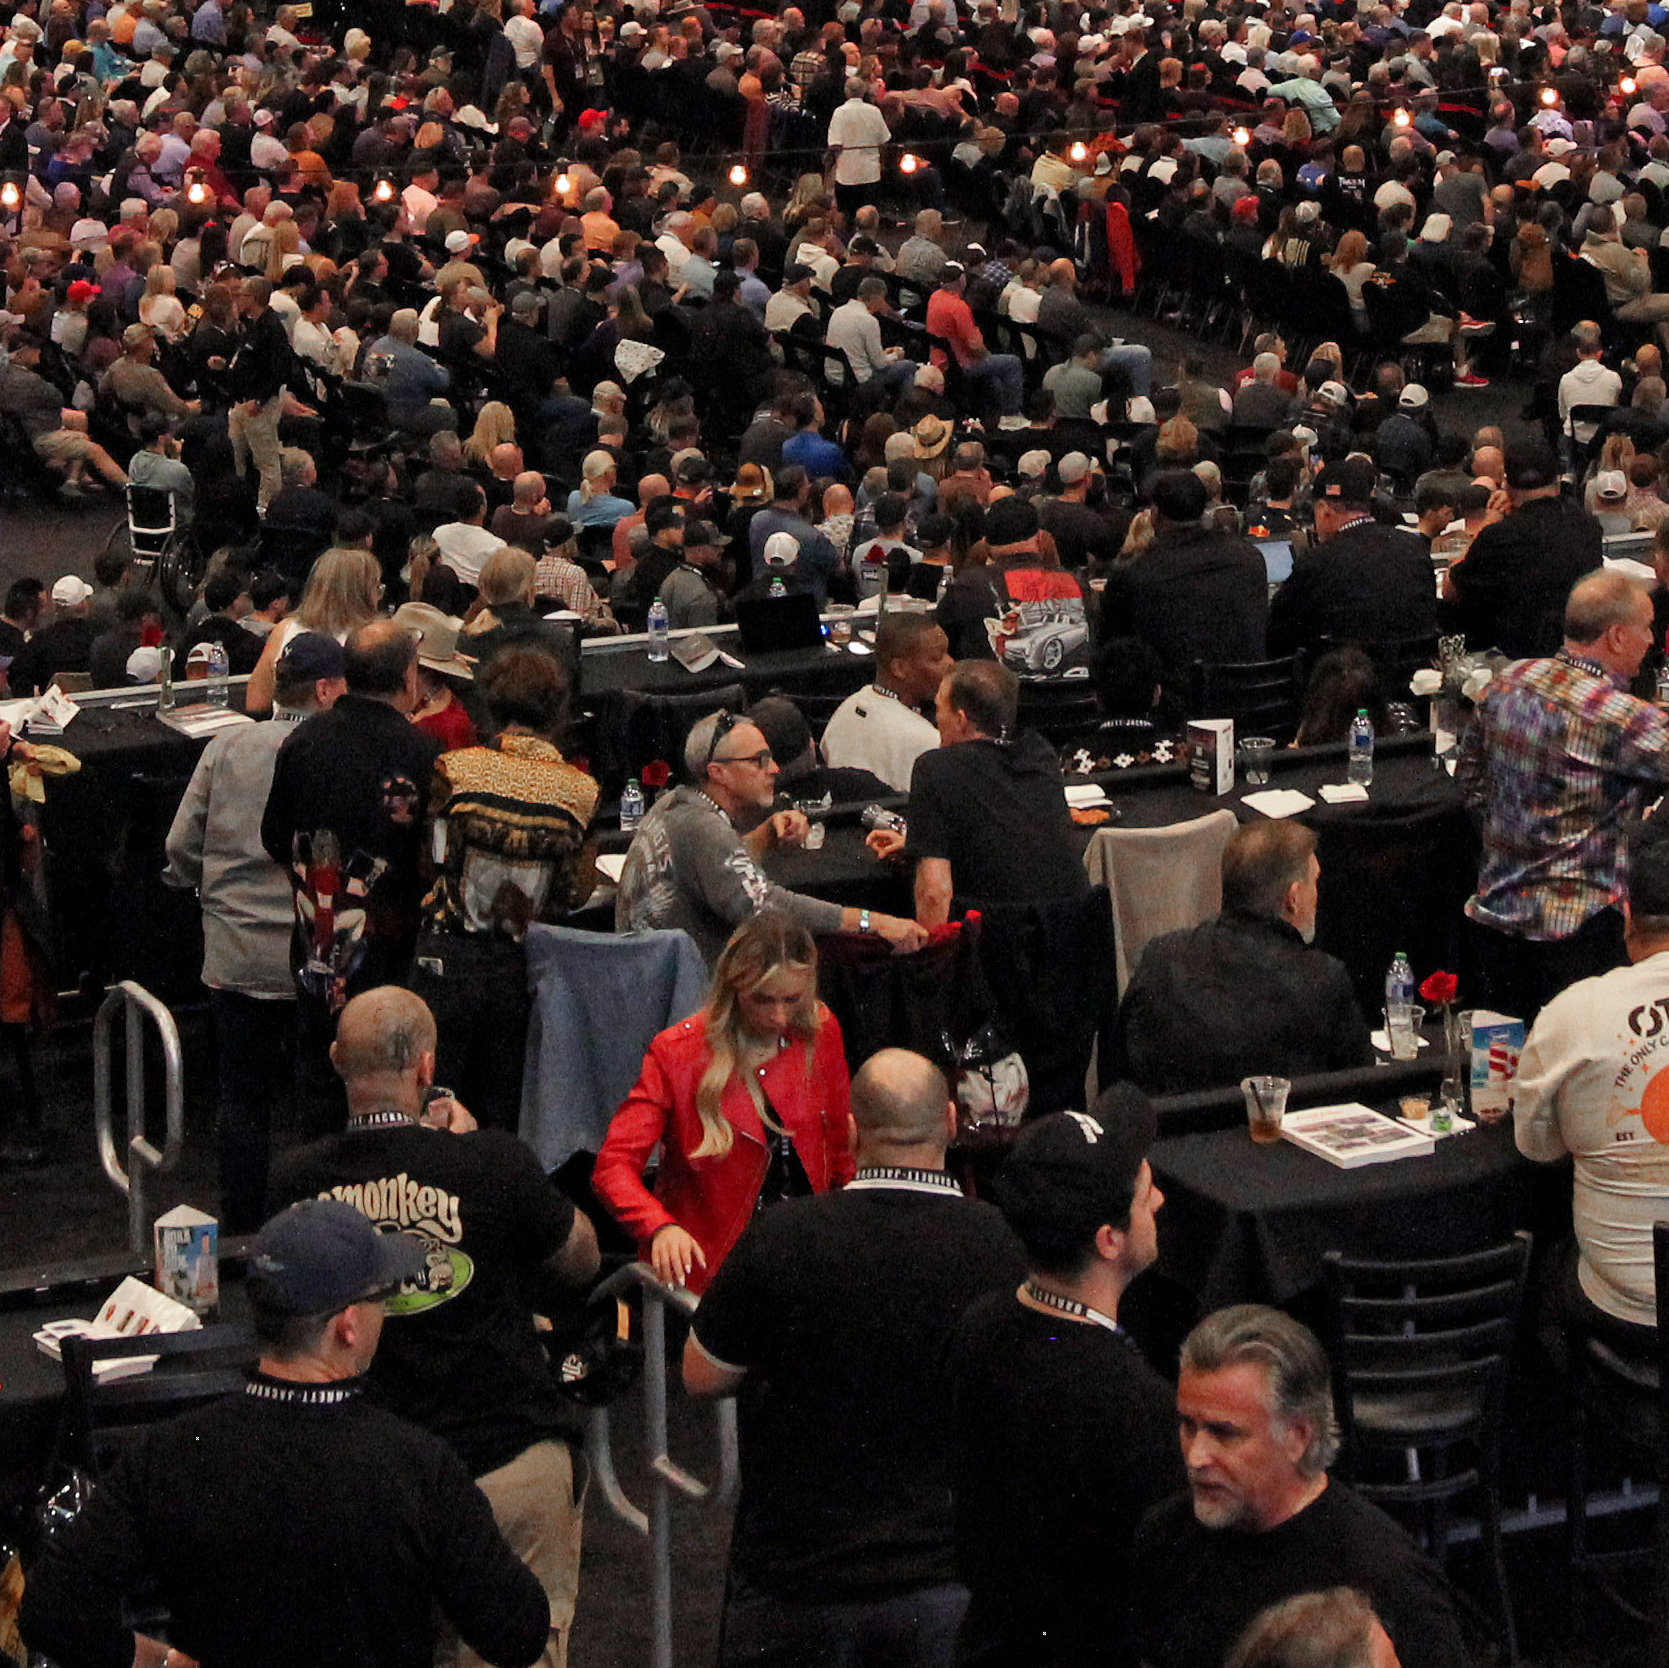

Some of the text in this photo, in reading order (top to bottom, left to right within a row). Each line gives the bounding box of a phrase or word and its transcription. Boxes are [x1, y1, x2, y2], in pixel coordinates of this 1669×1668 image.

[1614, 1064, 1634, 1089] THE
[1631, 1040, 1658, 1067] ONLY
[1616, 1132, 1635, 1142] EST
